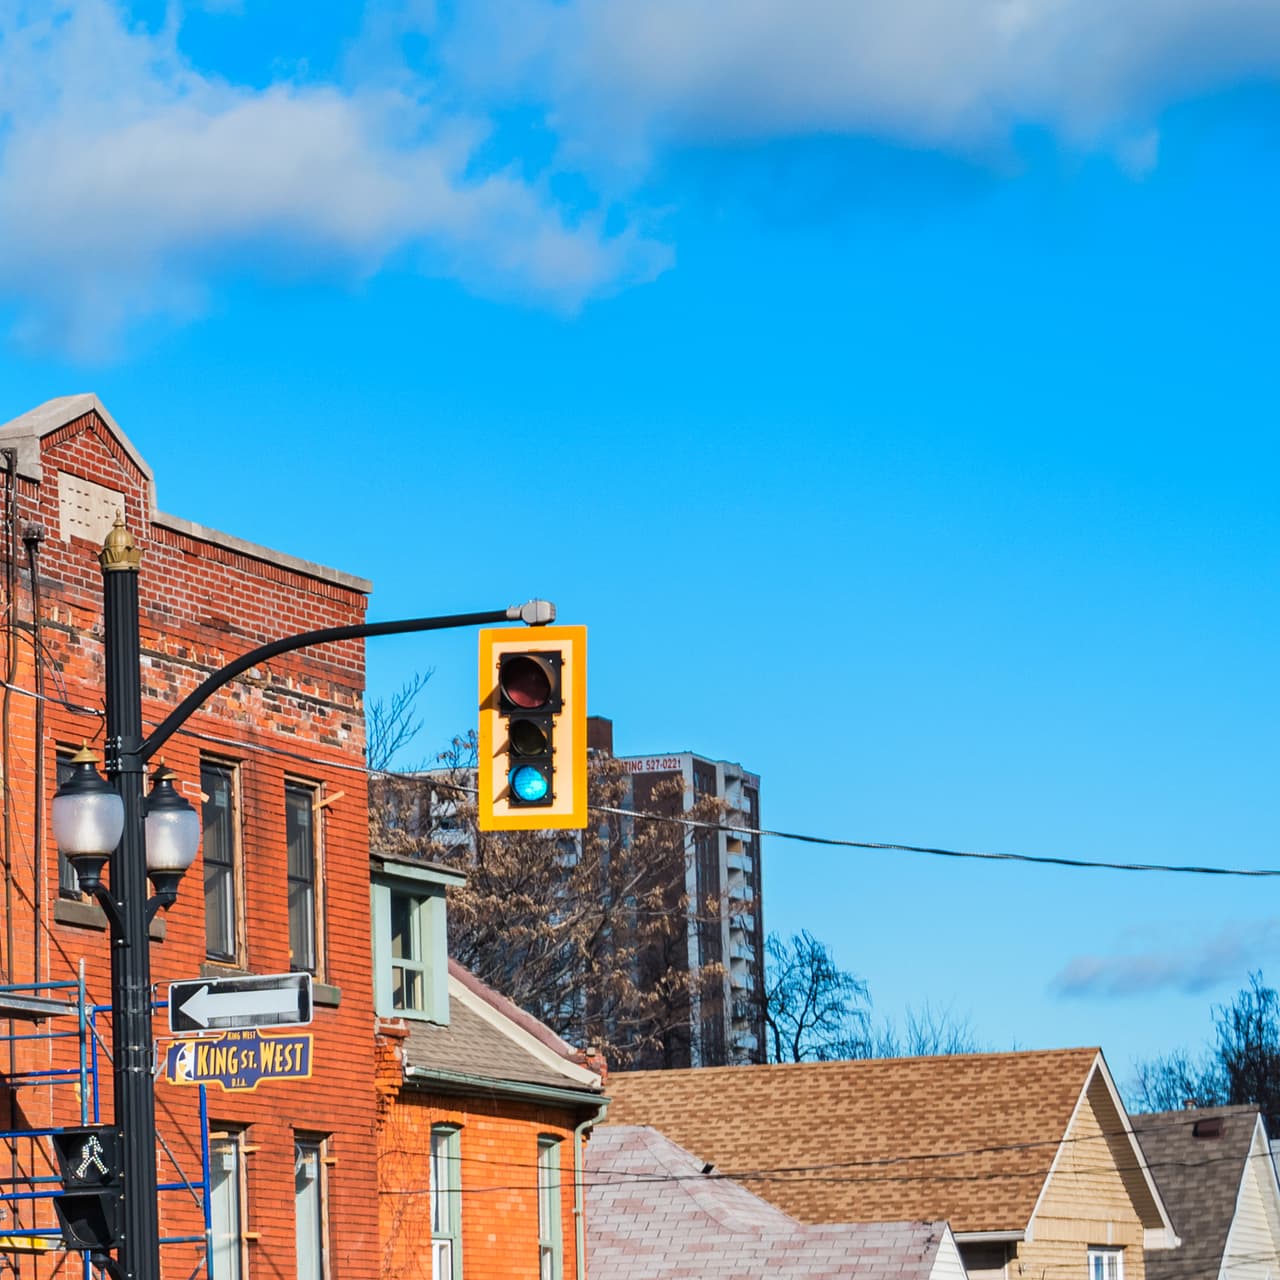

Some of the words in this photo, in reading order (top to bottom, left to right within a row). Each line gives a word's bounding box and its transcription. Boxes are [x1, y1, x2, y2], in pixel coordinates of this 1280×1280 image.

[646, 758, 681, 770] 527-0221
[197, 1045, 239, 1076] KING
[240, 1049, 257, 1069] ST.
[259, 1042, 304, 1073] WEST
